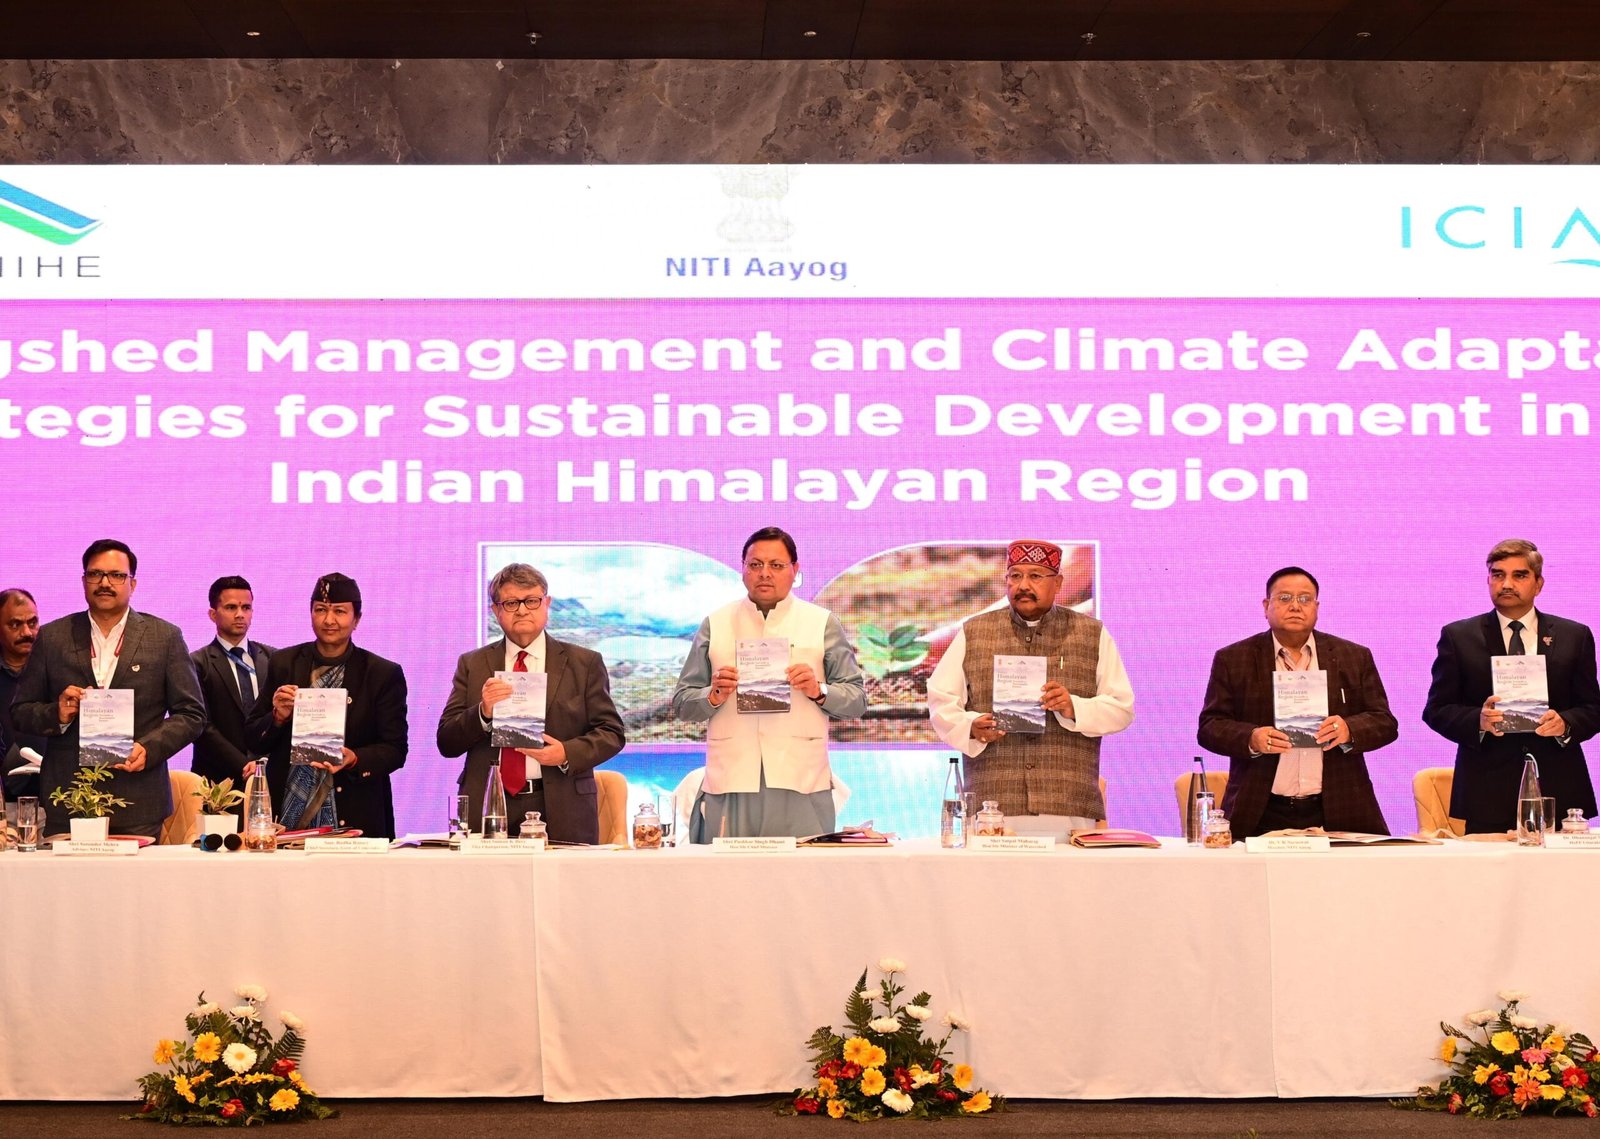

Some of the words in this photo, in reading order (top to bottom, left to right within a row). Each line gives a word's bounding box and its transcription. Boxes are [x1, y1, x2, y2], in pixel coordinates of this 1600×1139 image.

[0, 256, 100, 277] IHE
[666, 257, 730, 277] NITI
[744, 257, 848, 281] Aayog
[247, 331, 782, 380] Management
[811, 329, 961, 371] and
[992, 329, 1308, 371] Climate
[1338, 329, 1600, 379] Adapt
[275, 395, 393, 438] for
[424, 393, 903, 438] Sustainable
[935, 393, 1490, 444] Development
[1521, 393, 1589, 436] in
[272, 460, 523, 503] Indian
[557, 459, 987, 510] Himalayan
[1021, 459, 1308, 510] Region
